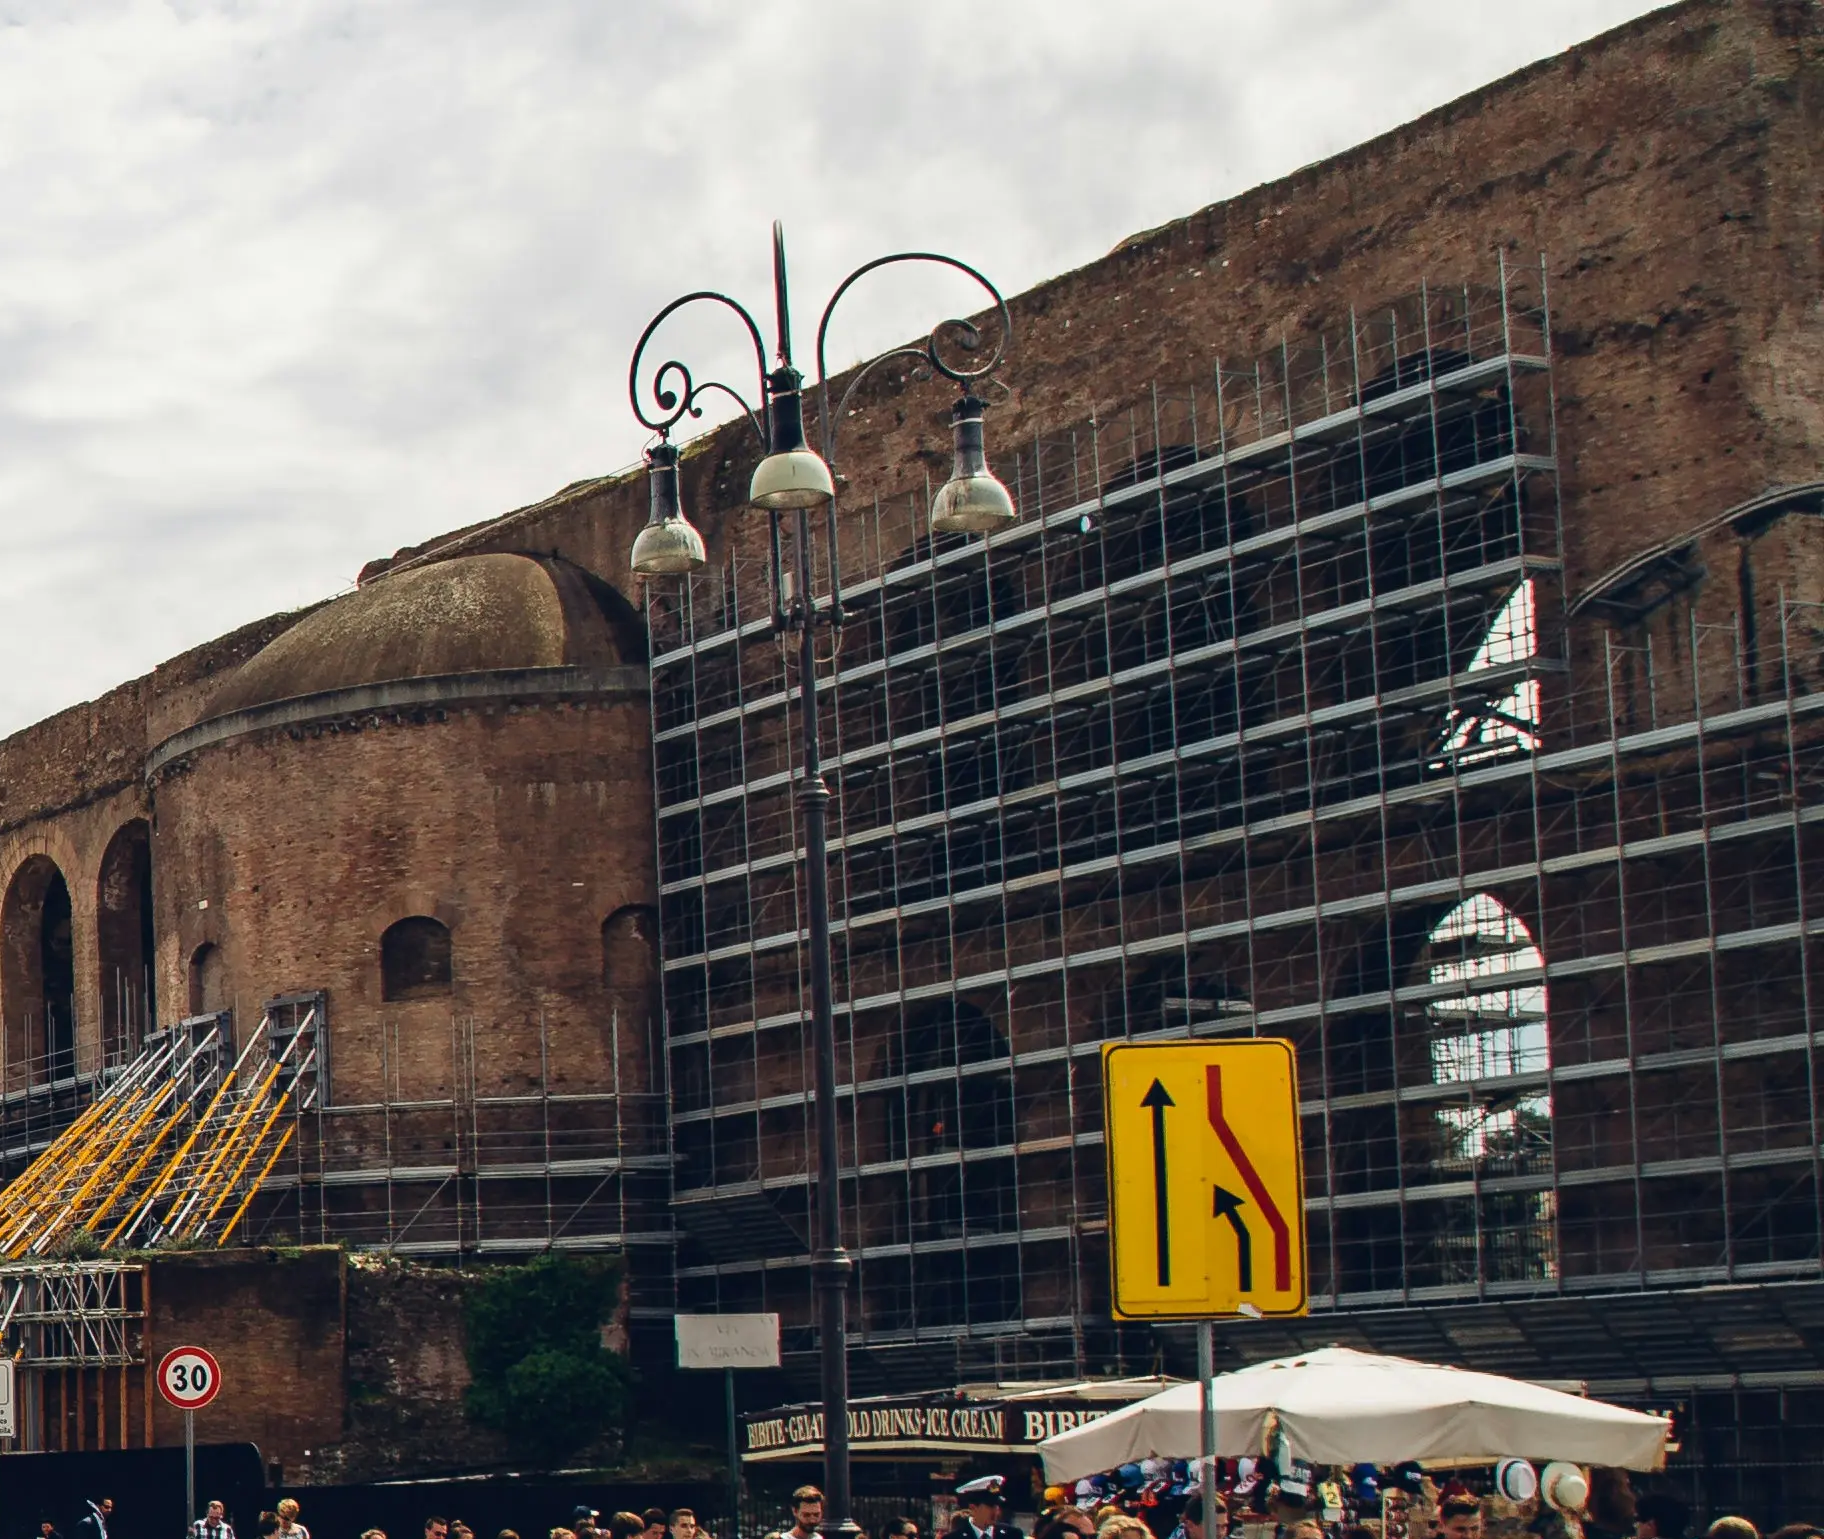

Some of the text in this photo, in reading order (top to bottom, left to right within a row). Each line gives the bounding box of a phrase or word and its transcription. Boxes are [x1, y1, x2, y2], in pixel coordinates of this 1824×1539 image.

[172, 1364, 207, 1392] 30
[746, 1407, 1003, 1449] BIBITE GELAT OLD DRINKS ICE CREAM
